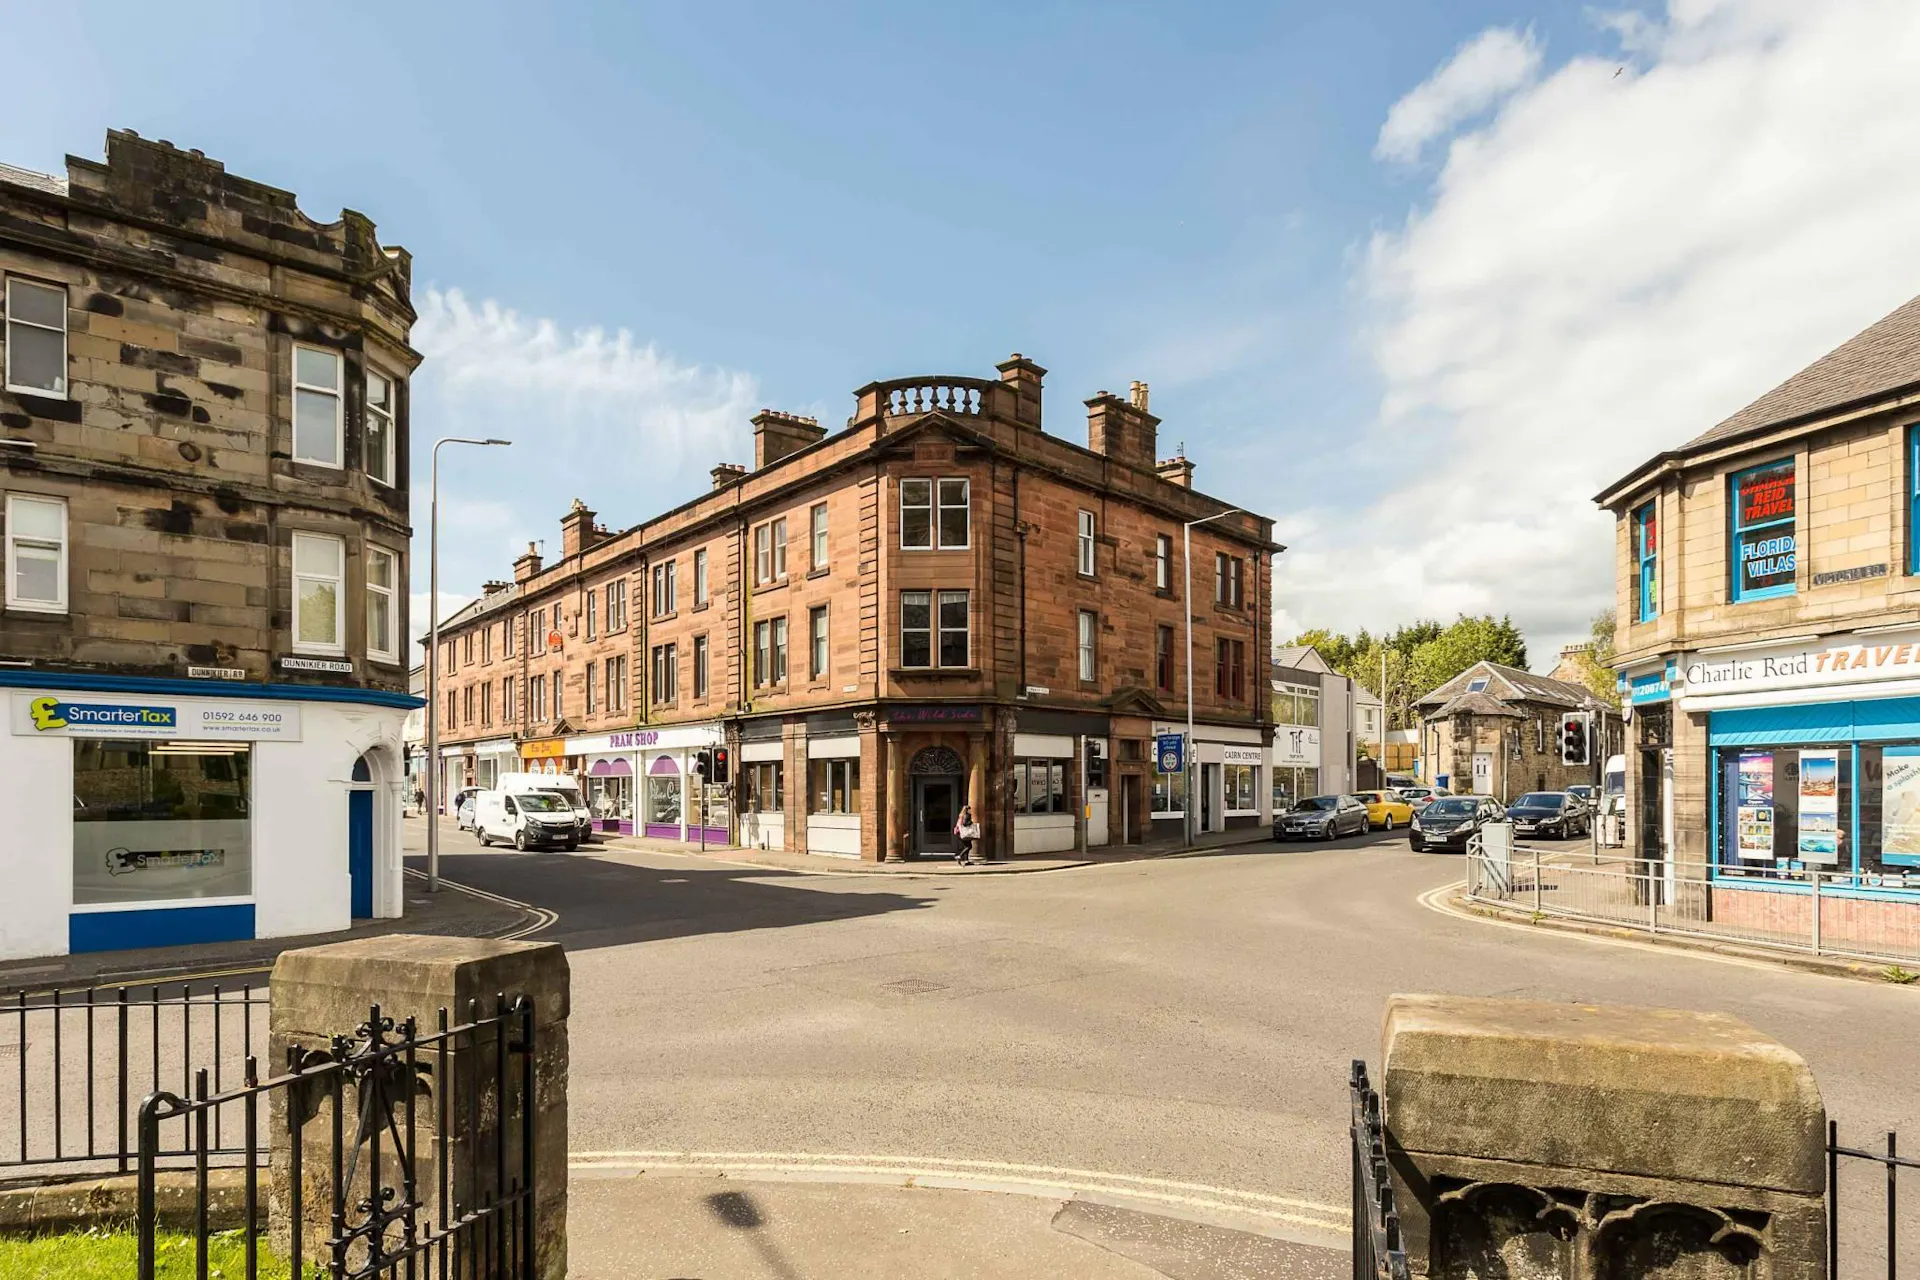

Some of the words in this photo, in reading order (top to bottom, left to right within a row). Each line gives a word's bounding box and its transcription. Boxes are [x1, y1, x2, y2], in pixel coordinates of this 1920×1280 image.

[1753, 487, 1786, 506] REID
[1745, 498, 1794, 520] TRAVEL
[1747, 554, 1796, 578] VILLAS
[191, 668, 229, 678] DUNNIKIER
[284, 659, 327, 670] DUNNIKIER
[329, 662, 351, 672] ROAD
[1686, 659, 1753, 684] Charlie
[1763, 652, 1808, 677] Reid
[69, 707, 171, 723] SmarterTax
[203, 711, 234, 721] 01592
[238, 712, 258, 722] 646
[262, 713, 282, 722] 900
[610, 733, 633, 748] PRAM
[635, 731, 659, 746] SHOP
[1224, 751, 1241, 759] CAIRN
[1242, 752, 1261, 760] CENTRE
[1886, 763, 1909, 779] Make
